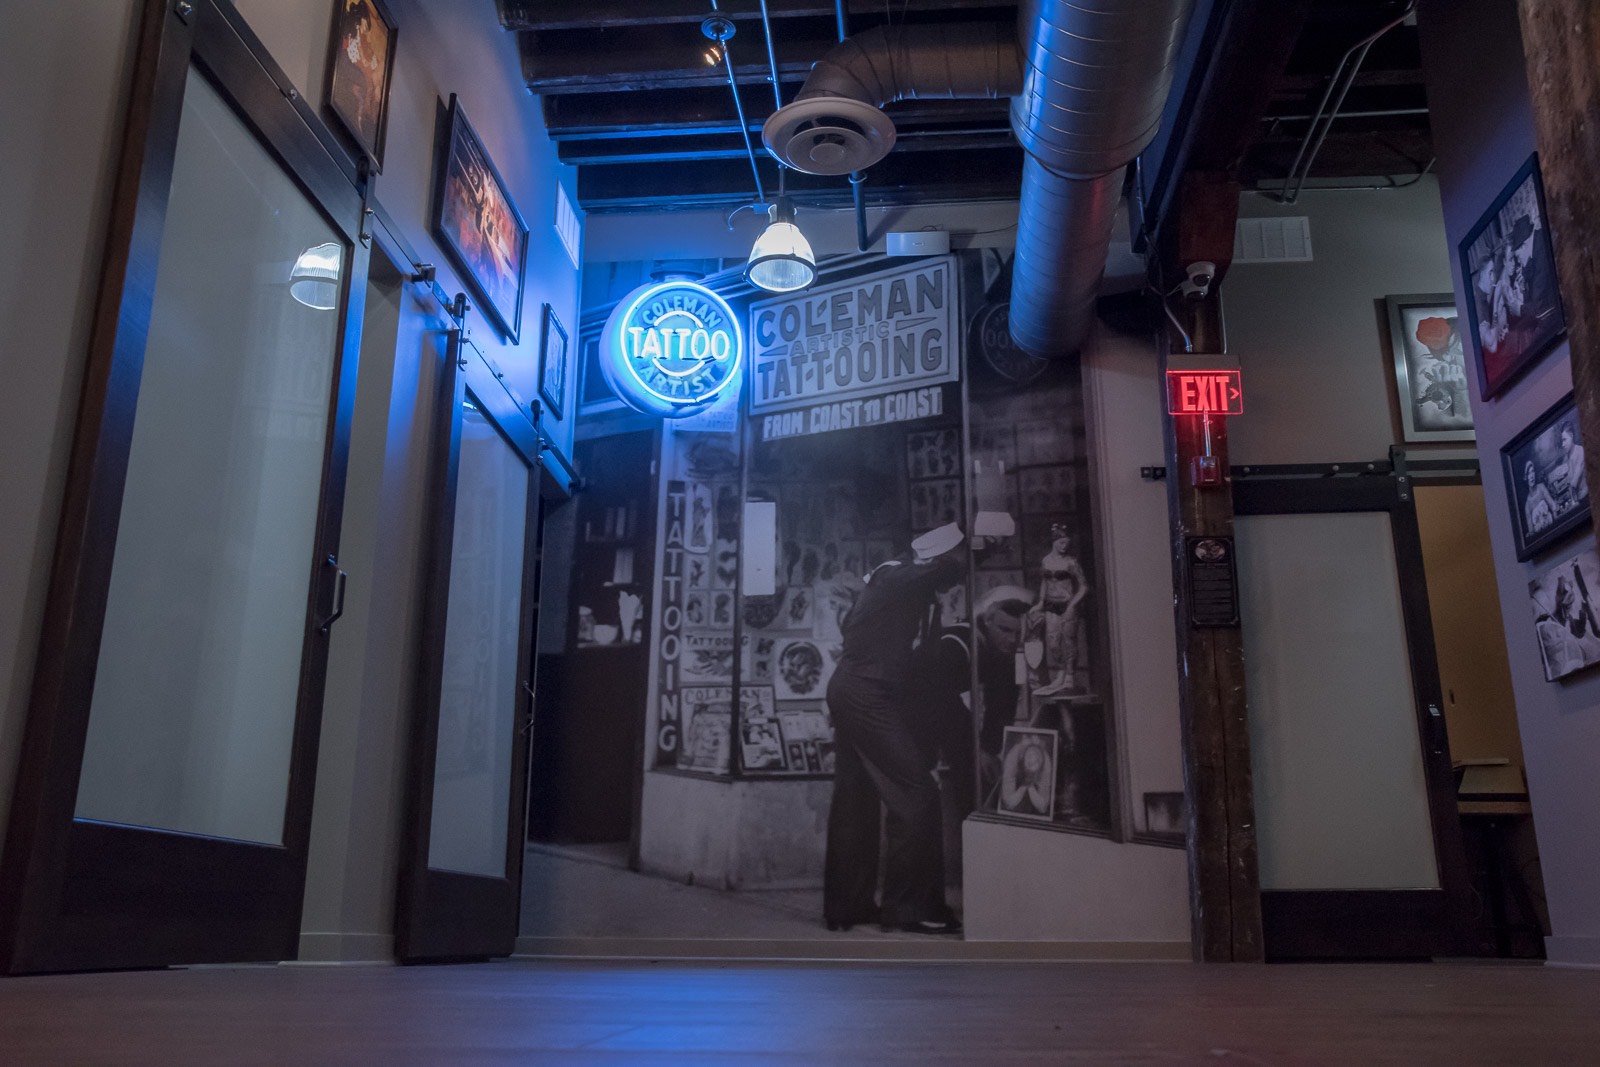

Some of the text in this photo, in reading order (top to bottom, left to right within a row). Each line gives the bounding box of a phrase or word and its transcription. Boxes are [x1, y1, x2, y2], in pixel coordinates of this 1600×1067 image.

[642, 295, 722, 329] COLEMAN
[757, 269, 943, 348] COLEMAN
[628, 326, 731, 361] TATTOO
[789, 320, 890, 357] ARTISTIC
[640, 366, 717, 396] ARTIST
[757, 328, 943, 400] TATTOOING
[1180, 375, 1230, 411] EXIT
[763, 411, 804, 440] FROM
[810, 400, 864, 433] COAST
[884, 386, 943, 422] COAST
[659, 492, 684, 751] TATTOOING
[685, 634, 749, 647] TATTOOG
